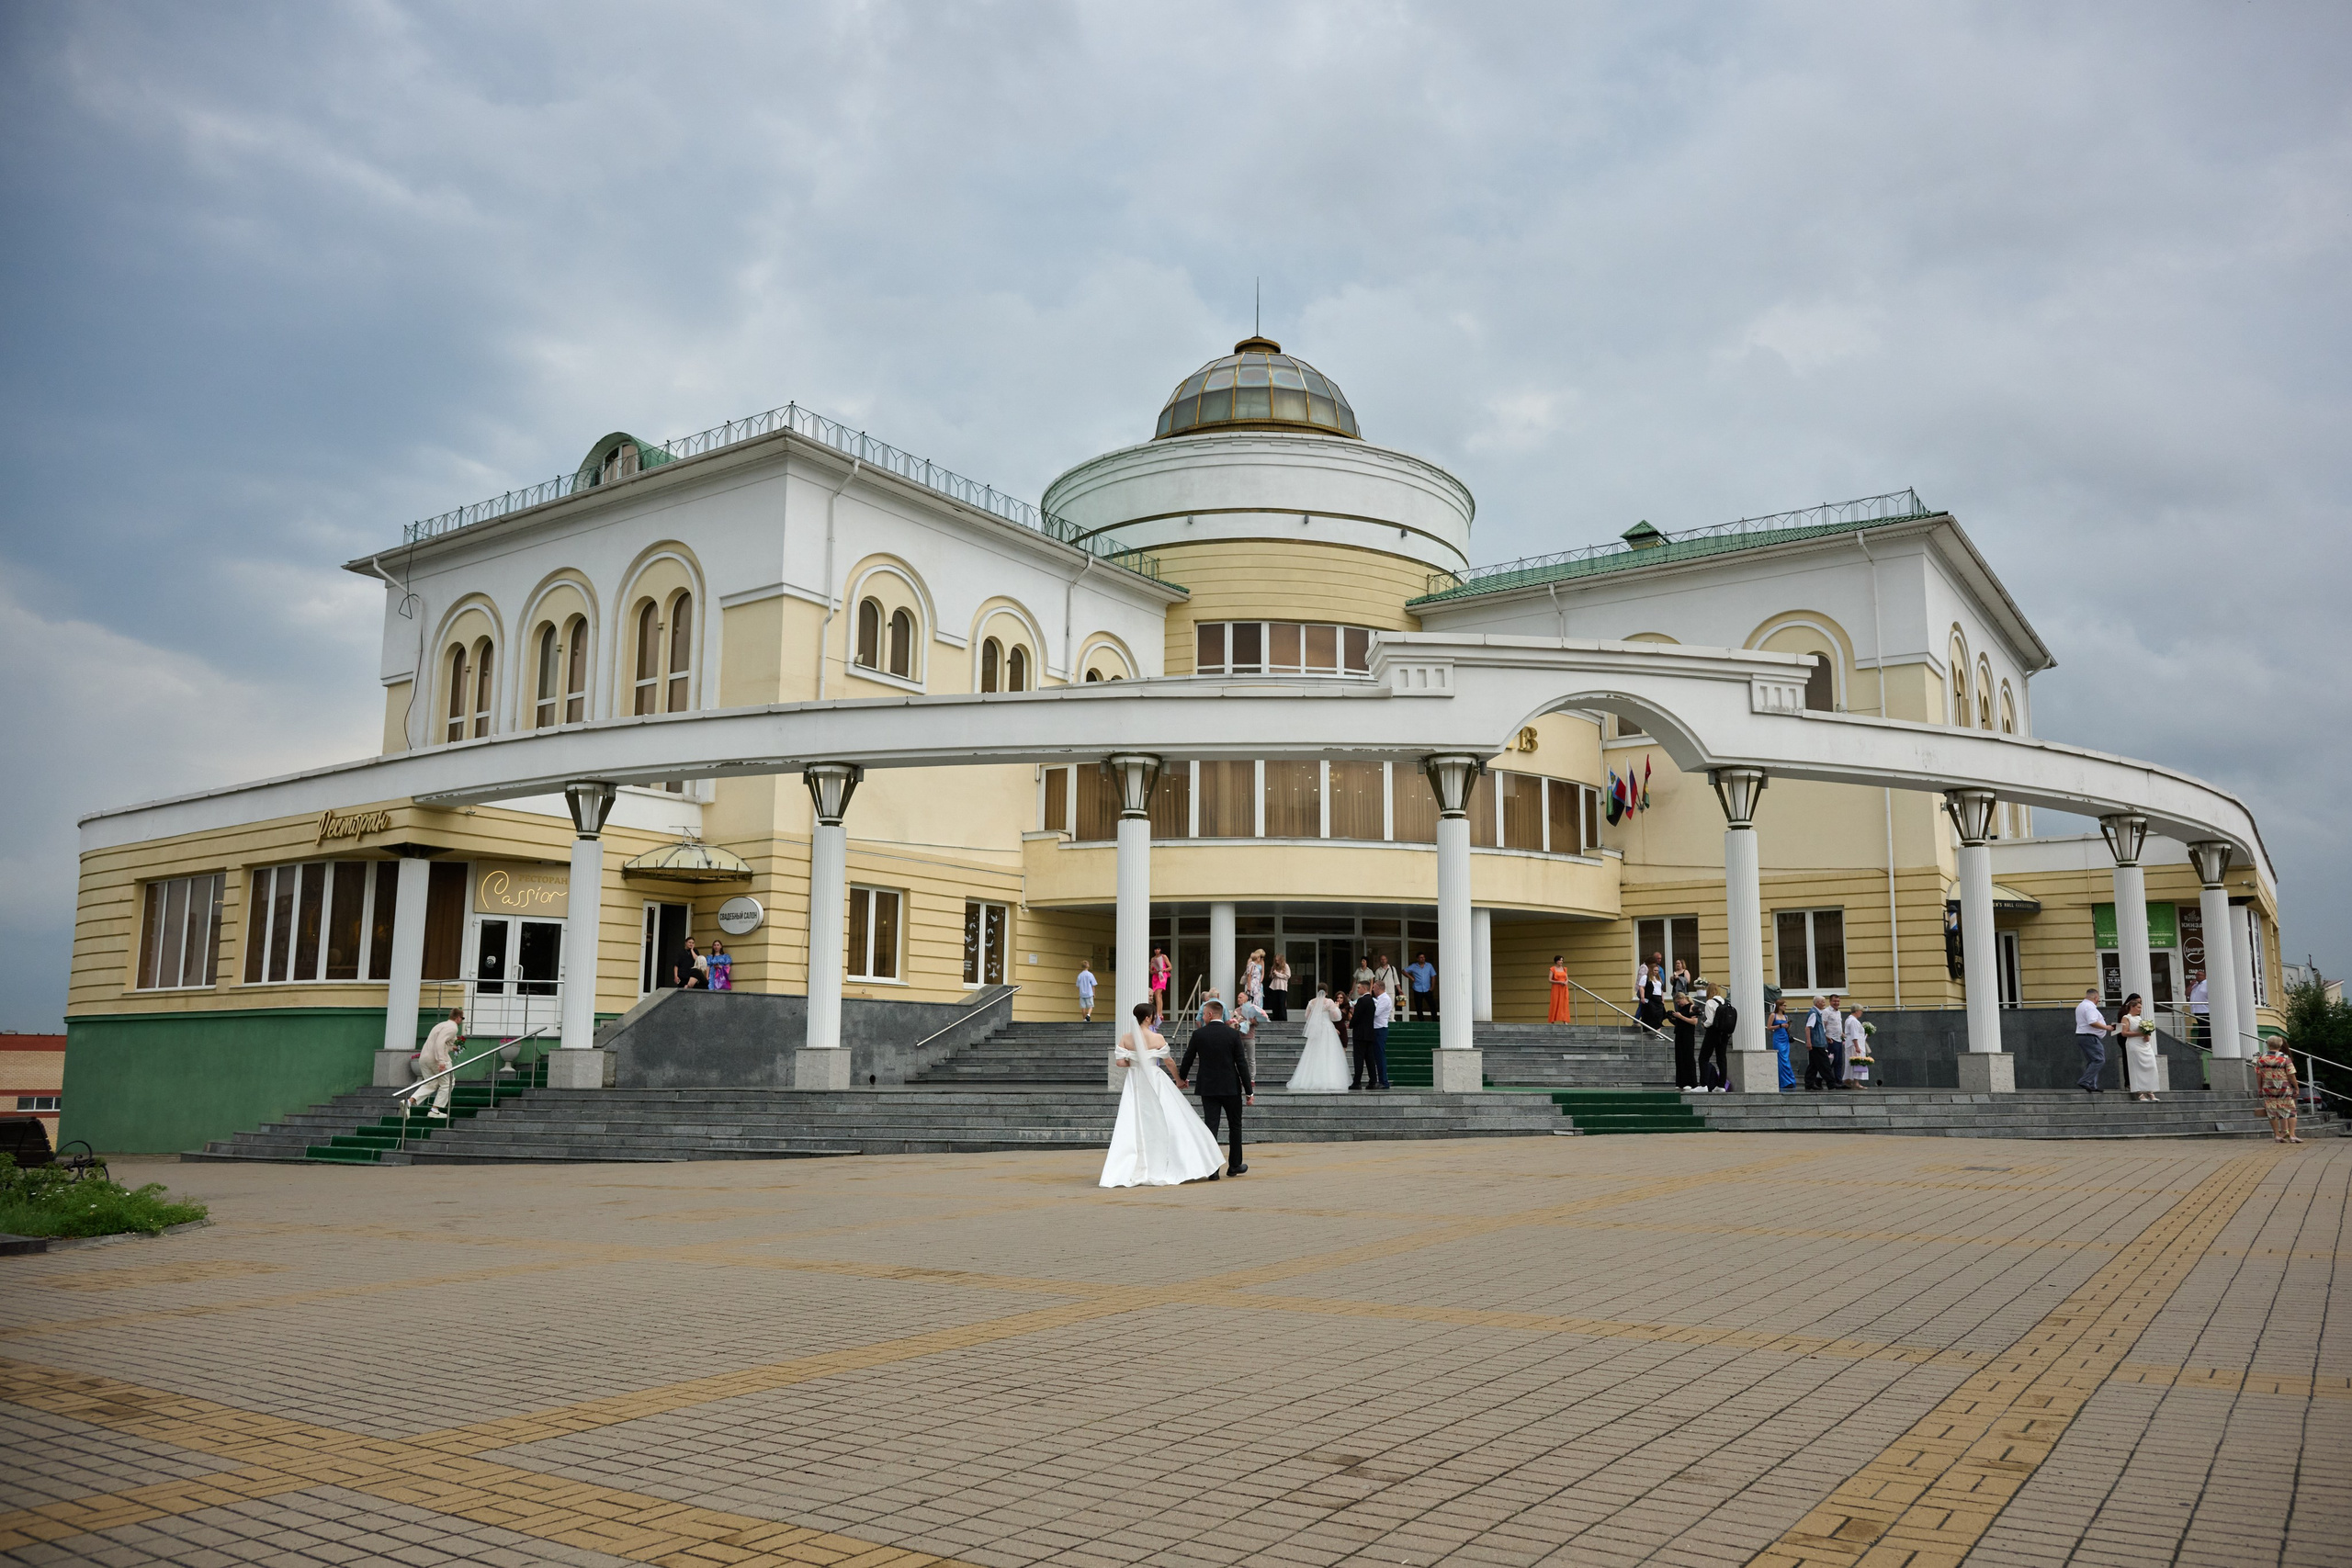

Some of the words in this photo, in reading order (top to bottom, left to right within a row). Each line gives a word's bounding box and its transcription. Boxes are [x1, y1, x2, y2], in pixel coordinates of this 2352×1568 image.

[314, 809, 390, 846] Ресторан
[517, 874, 569, 886] РЕСТОРАН
[719, 911, 743, 920] СВАДЕБНЫЙ
[743, 911, 758, 919] САЛОН
